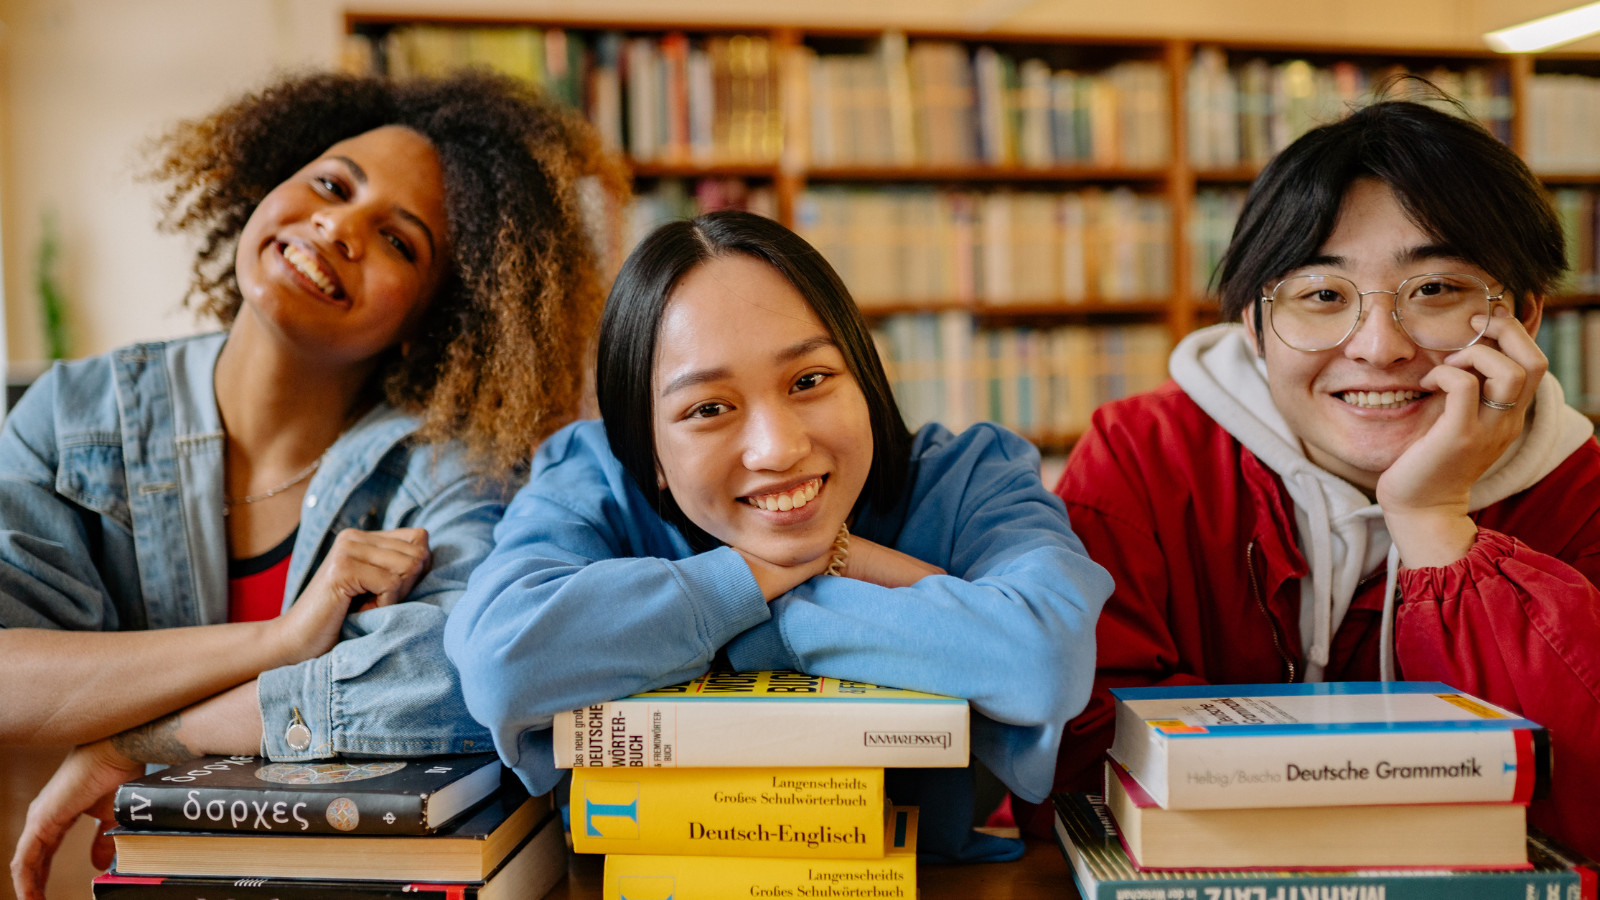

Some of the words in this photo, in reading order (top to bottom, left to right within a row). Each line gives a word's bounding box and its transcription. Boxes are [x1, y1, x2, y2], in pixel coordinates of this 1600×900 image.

[572, 708, 586, 728] groß
[574, 730, 584, 752] neue
[588, 704, 604, 767] DEUTSCHE
[608, 710, 626, 767] WÖRTER-
[652, 709, 662, 761] FREMDWÖRTER-
[573, 753, 584, 768] Das
[629, 735, 644, 767] BUCH
[663, 744, 672, 761] BUCH
[1286, 760, 1370, 782] Deutsche
[1375, 757, 1483, 780] Grammatik
[771, 776, 868, 792] Langenscheidts
[129, 791, 153, 822] IV
[713, 790, 757, 805] Großes
[760, 792, 868, 807] Schulwörterbuch
[688, 821, 868, 849] Deutsch-Englisch
[807, 868, 904, 884] Langenscheidts
[750, 885, 794, 898] Großes
[797, 885, 904, 898] Schulwörterbuch
